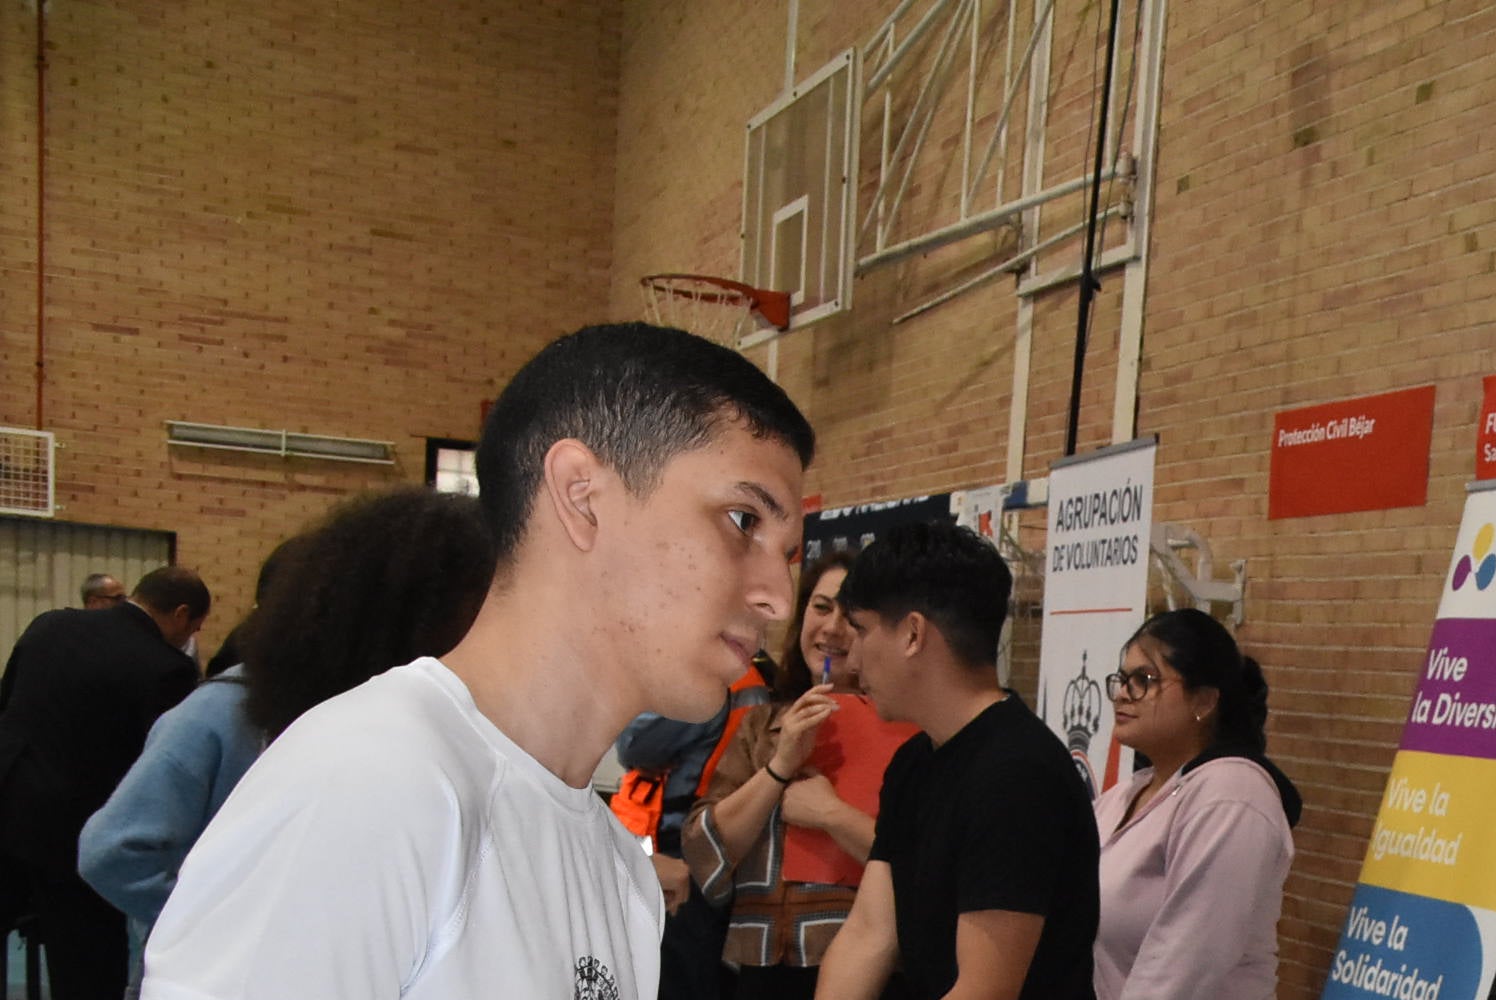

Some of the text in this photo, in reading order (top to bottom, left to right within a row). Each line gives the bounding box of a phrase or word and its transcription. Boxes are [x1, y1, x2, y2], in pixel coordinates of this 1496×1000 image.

[1278, 415, 1375, 447] Protección Civil Béjar
[1056, 477, 1143, 533] AGRUPACIÓN
[1053, 533, 1138, 572] DE VOLUNTARIOS
[1427, 647, 1468, 682] Vive
[1411, 691, 1430, 723] la
[1387, 778, 1449, 816] Vive la
[1372, 819, 1462, 865] Igualdad
[1347, 906, 1409, 950] Vive la
